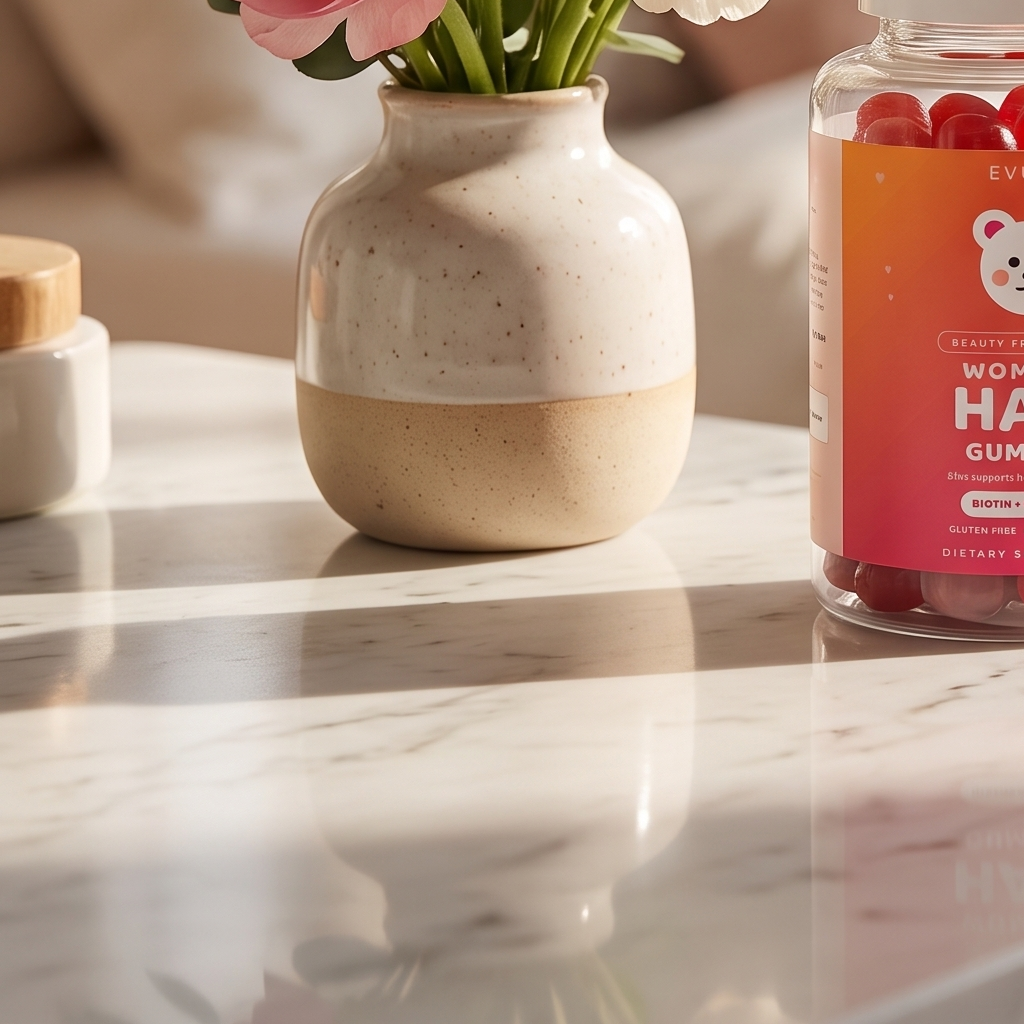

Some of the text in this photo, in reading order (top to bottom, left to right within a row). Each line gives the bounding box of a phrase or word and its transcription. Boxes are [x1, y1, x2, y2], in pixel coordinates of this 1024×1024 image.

[951, 338, 1005, 349] BEAUTY
[971, 473, 1015, 484] supports
[972, 499, 1012, 509] BIOTIN
[949, 525, 988, 535] GLUTEN
[942, 548, 1006, 559] DIETARY
